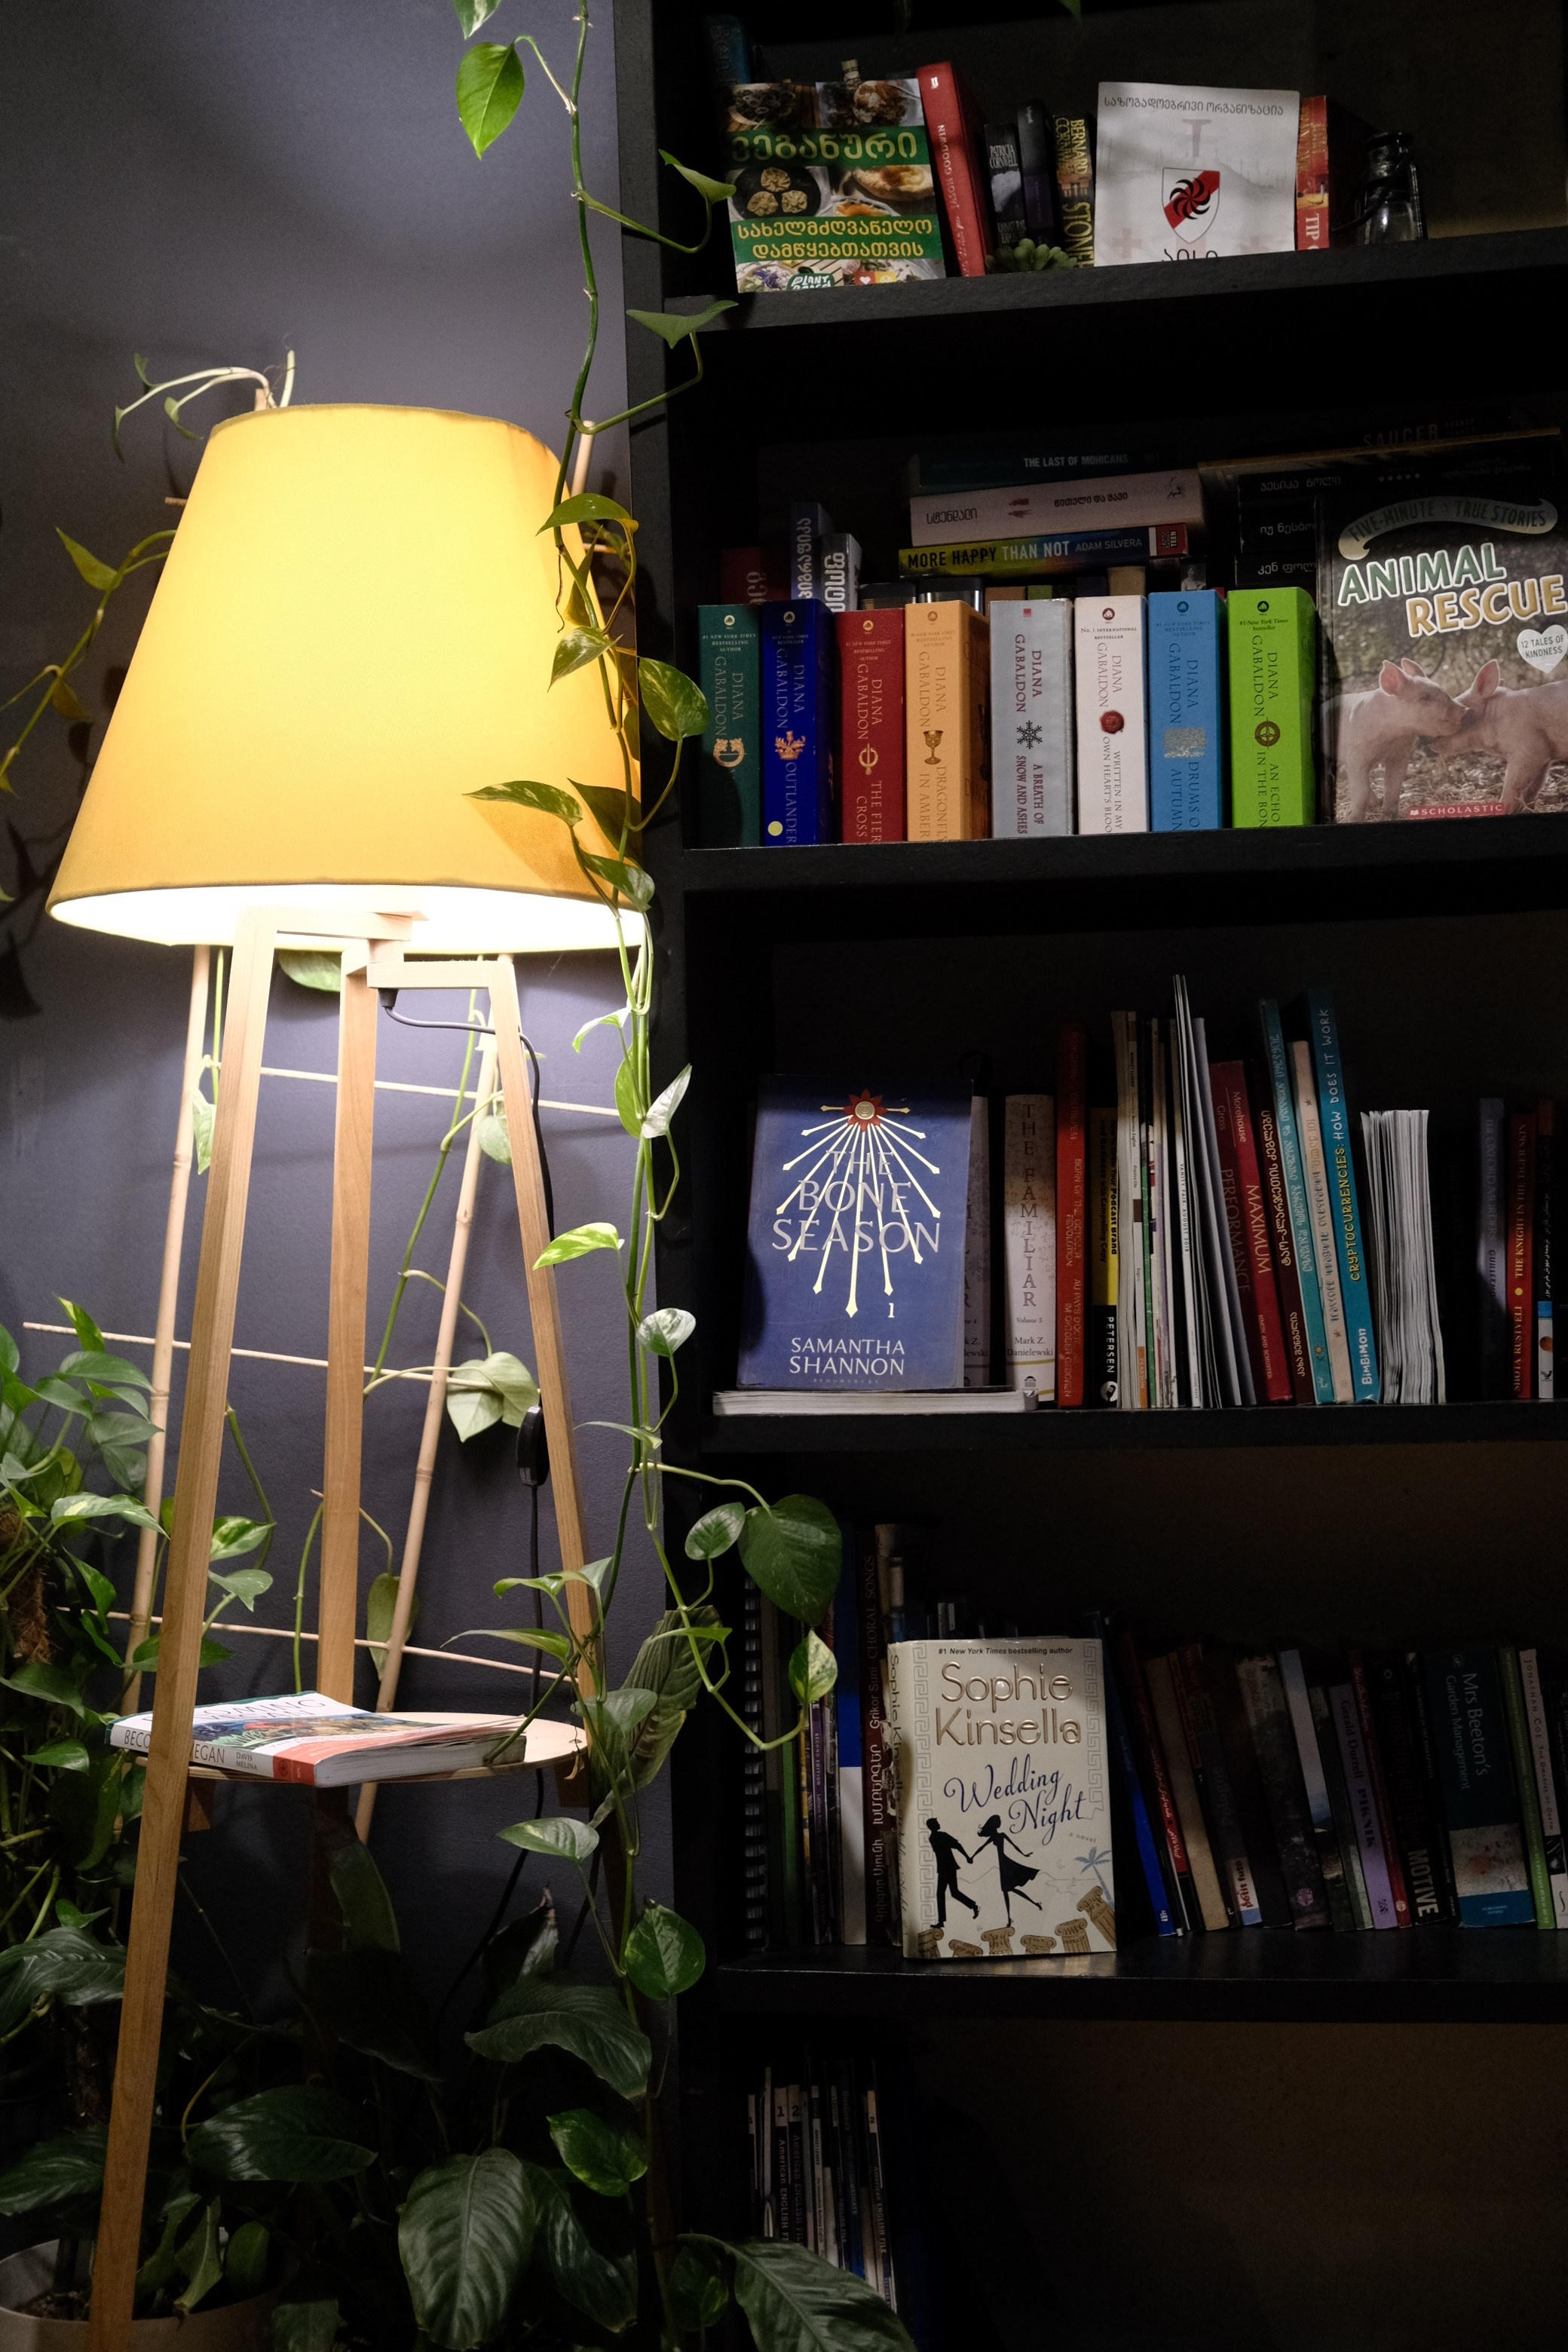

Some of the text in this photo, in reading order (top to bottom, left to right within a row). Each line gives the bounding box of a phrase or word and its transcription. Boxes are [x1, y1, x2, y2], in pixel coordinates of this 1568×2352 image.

[1104, 96, 1285, 115] საზოგადოებრივი ორგანიზაცია
[730, 131, 918, 162] ვეგანური
[937, 124, 952, 175] GOODWIN
[1070, 118, 1089, 176] BERNARD
[737, 219, 933, 240] სახელმძღვანელო
[752, 241, 924, 259] დამწყებთათვის
[1305, 213, 1321, 240] TIP
[1023, 458, 1041, 468] THE
[1043, 456, 1065, 467] LAST
[1067, 455, 1079, 467] OF
[1081, 454, 1129, 466] MOHICANS
[1260, 476, 1342, 492] ჯესიკა ნოლი
[926, 508, 978, 525] სტენდალი
[1055, 492, 1129, 508] წითელი და შავი
[1454, 503, 1547, 528] TRUE STORIES
[908, 538, 1143, 569] MORE HAPPY THAN NOT ADAM SILVERA
[1260, 524, 1274, 536] იუ
[1257, 561, 1279, 575] კენ
[1337, 542, 1507, 606] ANIMAL
[1406, 574, 1568, 638] RESCUE
[1524, 645, 1564, 660] KINDNESS
[1531, 634, 1566, 648] TALES OF
[714, 655, 727, 737] GABALDON
[732, 672, 745, 721] DIANA
[775, 648, 789, 729] GABALDON
[793, 664, 805, 714] DIANA
[918, 651, 930, 727] GABALDON
[936, 666, 946, 712] DIANA
[1015, 634, 1026, 712] GABALDON
[1032, 650, 1043, 698] DIANA
[1097, 642, 1109, 707] GABALDON
[1111, 654, 1122, 694] DIANA
[1168, 643, 1181, 724] GABALDON
[1187, 660, 1199, 709] DIANA
[1252, 635, 1263, 716] GABALDON
[1267, 652, 1279, 700] DIANA
[857, 664, 869, 740] GABALDON
[871, 679, 883, 725] DIANA
[871, 781, 882, 807] THE
[1016, 755, 1028, 835] SNOW AND ASHES
[1033, 773, 1044, 809] BREATH
[1113, 751, 1122, 810] WRITTEN IN
[1188, 761, 1200, 813] DRUMS
[1257, 752, 1267, 796] IN THE
[1269, 764, 1281, 822] AN ECHO
[785, 762, 798, 844] OUTLANDER
[856, 796, 868, 838] CROSS
[919, 773, 930, 839] IN AMBER
[1034, 813, 1044, 825] OF
[1420, 803, 1504, 816] SCHOLASTIC
[1320, 1007, 1345, 1141] HOW DOES WORK
[1216, 1105, 1227, 1132] Gross
[1233, 1091, 1247, 1143] Morehouse
[1306, 1118, 1317, 1132] 101
[825, 1150, 894, 1175] THE
[798, 1180, 911, 1212] BONE
[1260, 1109, 1292, 1266] ტაო-კლარჯეთის ძეგლები
[1282, 1125, 1313, 1272] და გარემოს დაცვაზე
[771, 1218, 941, 1254] SEASON
[1020, 1168, 1038, 1307] FAMILIAR
[1220, 1168, 1251, 1292] PERFORMANCE
[1245, 1185, 1272, 1274] MAXIMUM
[887, 1303, 895, 1318] 1
[1512, 1217, 1527, 1392] SHOTA RUSTVELI THE KNIGHT
[791, 1337, 905, 1355] SAMANTHA
[1006, 1348, 1054, 1357] Danielewski
[1015, 1337, 1036, 1345] Mark
[1105, 1316, 1115, 1374] PETERSEN
[1289, 1311, 1306, 1377] კახა შენგელია
[789, 1356, 905, 1376] SHANNON
[864, 1555, 880, 1730] Grikor Suni CHORAL SONGS
[1008, 1647, 1048, 1655] bestselling
[890, 1654, 900, 1722] Sophie
[942, 1661, 1073, 1713] Sophie
[1524, 1659, 1539, 1713] JONATHAN
[935, 1706, 1082, 1746] Kinsella
[1340, 1700, 1356, 1736] Gerald
[1446, 1674, 1471, 1792] Garden Management
[1461, 1673, 1492, 1777] Mrs Beeton's
[235, 1760, 258, 1771] MELINA
[236, 1751, 253, 1762] DAVIS
[1347, 1738, 1364, 1779] Durrell
[943, 1753, 1064, 1813] Wedding
[869, 1744, 887, 1922] Գրիգոր Սյունի ԽՄԲԵՐԳԵՐ
[1008, 1783, 1088, 1846] Night
[1075, 1833, 1097, 1843] novel
[1357, 1787, 1377, 1848] PIKNIK
[1406, 1848, 1441, 1919] MOTIVE
[777, 2105, 785, 2117] 1
[792, 2105, 800, 2117] 2
[777, 2138, 790, 2231] American ENGLISH
[876, 2203, 887, 2254] ENGLISH FILE
